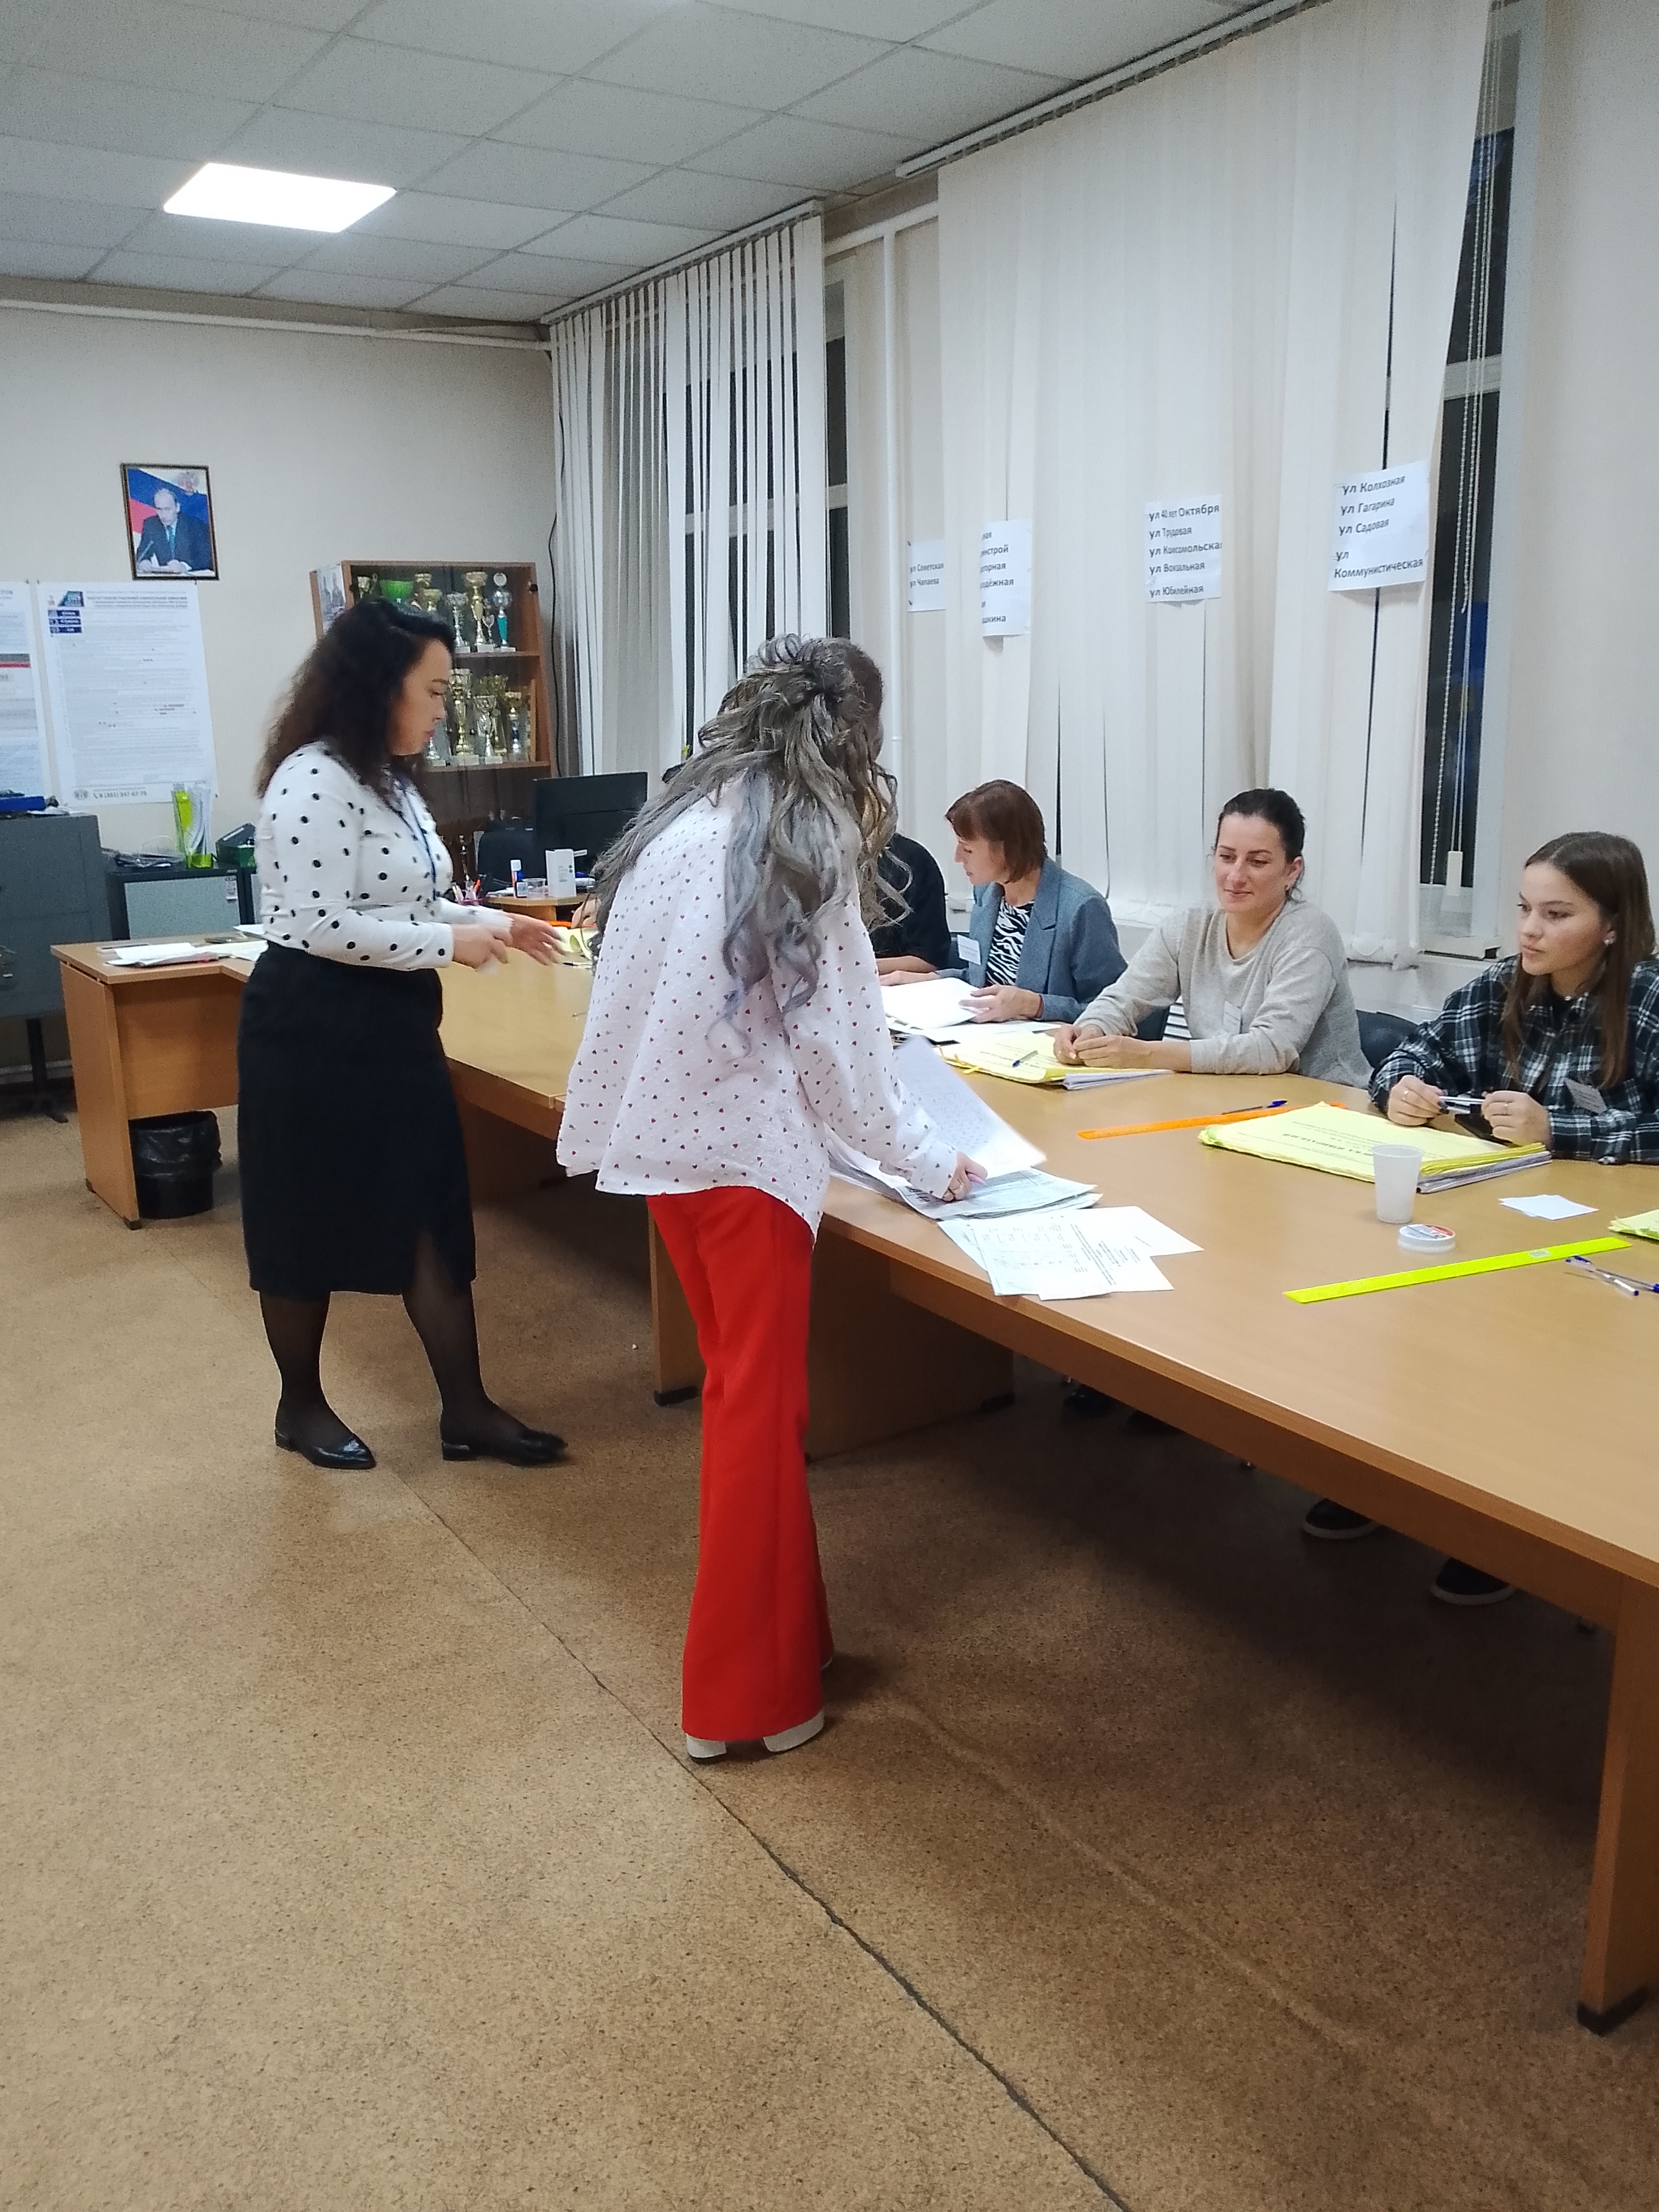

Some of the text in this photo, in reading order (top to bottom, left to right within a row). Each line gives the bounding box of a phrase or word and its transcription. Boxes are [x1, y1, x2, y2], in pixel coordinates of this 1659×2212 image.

[1343, 476, 1405, 496] ул Колхозная
[1149, 512, 1160, 522] ул
[1161, 509, 1168, 518] 40
[1179, 504, 1219, 517] Октября
[1340, 498, 1395, 516] ул Гагарина
[1149, 527, 1192, 540] ул Трудовая
[1339, 518, 1389, 536] ул Садовая
[1149, 548, 1161, 558] ул
[1336, 551, 1350, 562] ул
[917, 563, 944, 572] Советская
[1149, 562, 1205, 575] ул Вокзальная
[1334, 558, 1423, 578] Коммунистическая
[1150, 585, 1204, 598] ул Юбилейная
